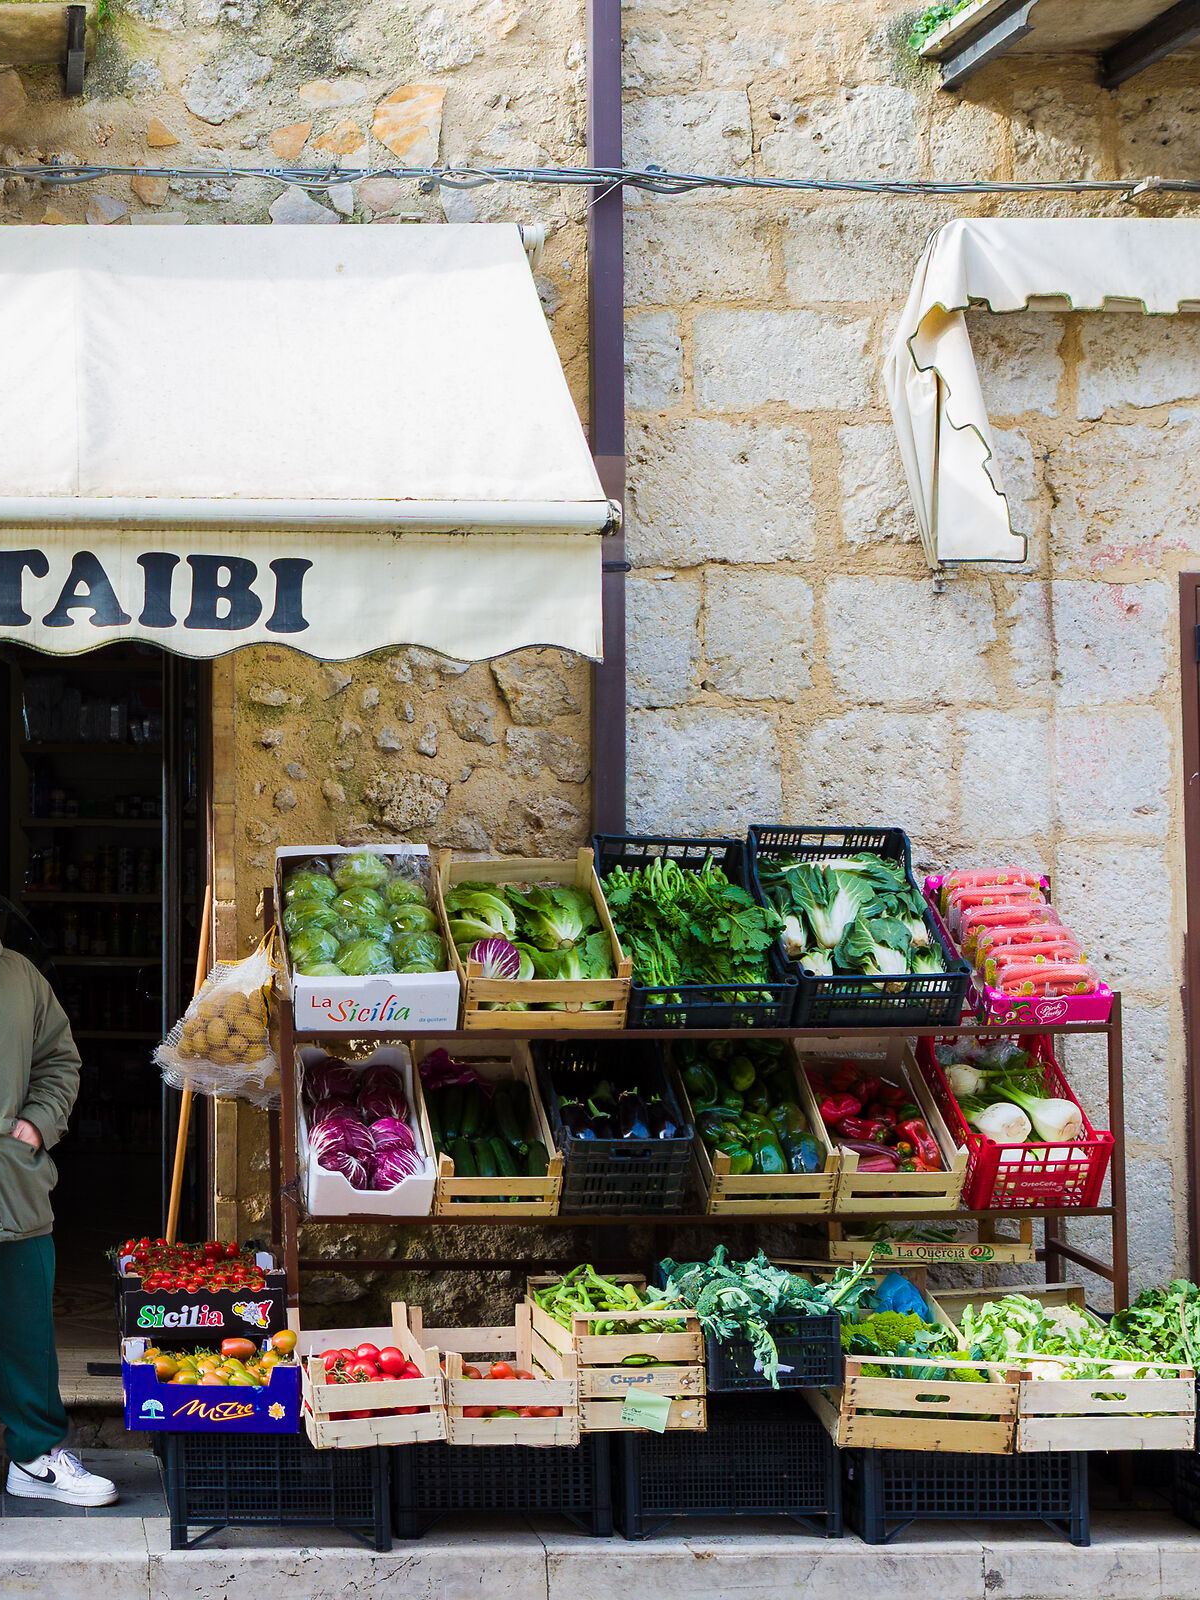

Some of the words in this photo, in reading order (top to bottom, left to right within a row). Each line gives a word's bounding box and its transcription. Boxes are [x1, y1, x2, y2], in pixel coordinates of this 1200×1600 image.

[311, 995, 332, 1008] La
[327, 994, 411, 1023] Sicilia
[1039, 1002, 1061, 1014] Pink
[896, 1246, 913, 1257] La
[916, 1246, 966, 1259] Quercia
[137, 1304, 225, 1328] Sicilia
